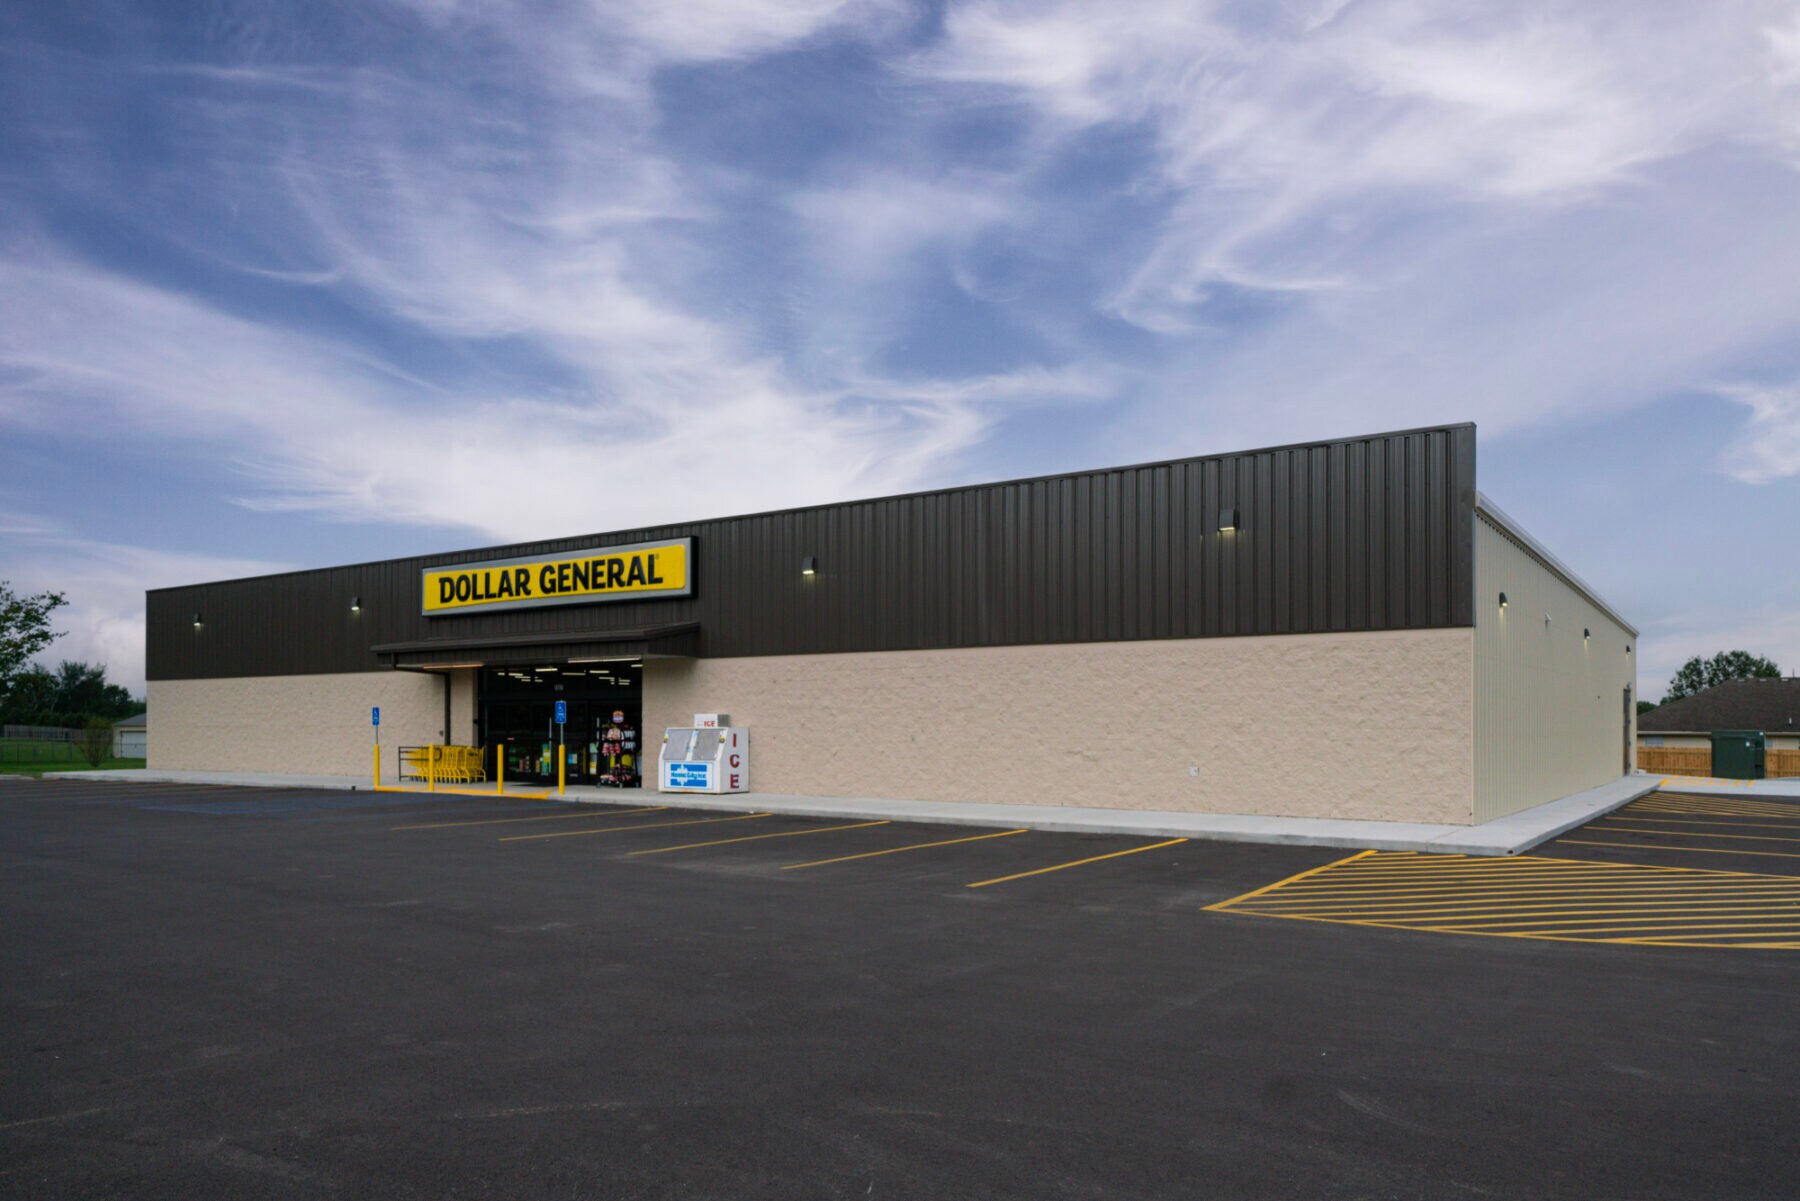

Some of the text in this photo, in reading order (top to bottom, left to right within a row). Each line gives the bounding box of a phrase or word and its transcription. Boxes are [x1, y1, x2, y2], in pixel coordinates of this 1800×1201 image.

[439, 553, 664, 604] DOLLAR GENERAL
[729, 733, 740, 789] ICE
